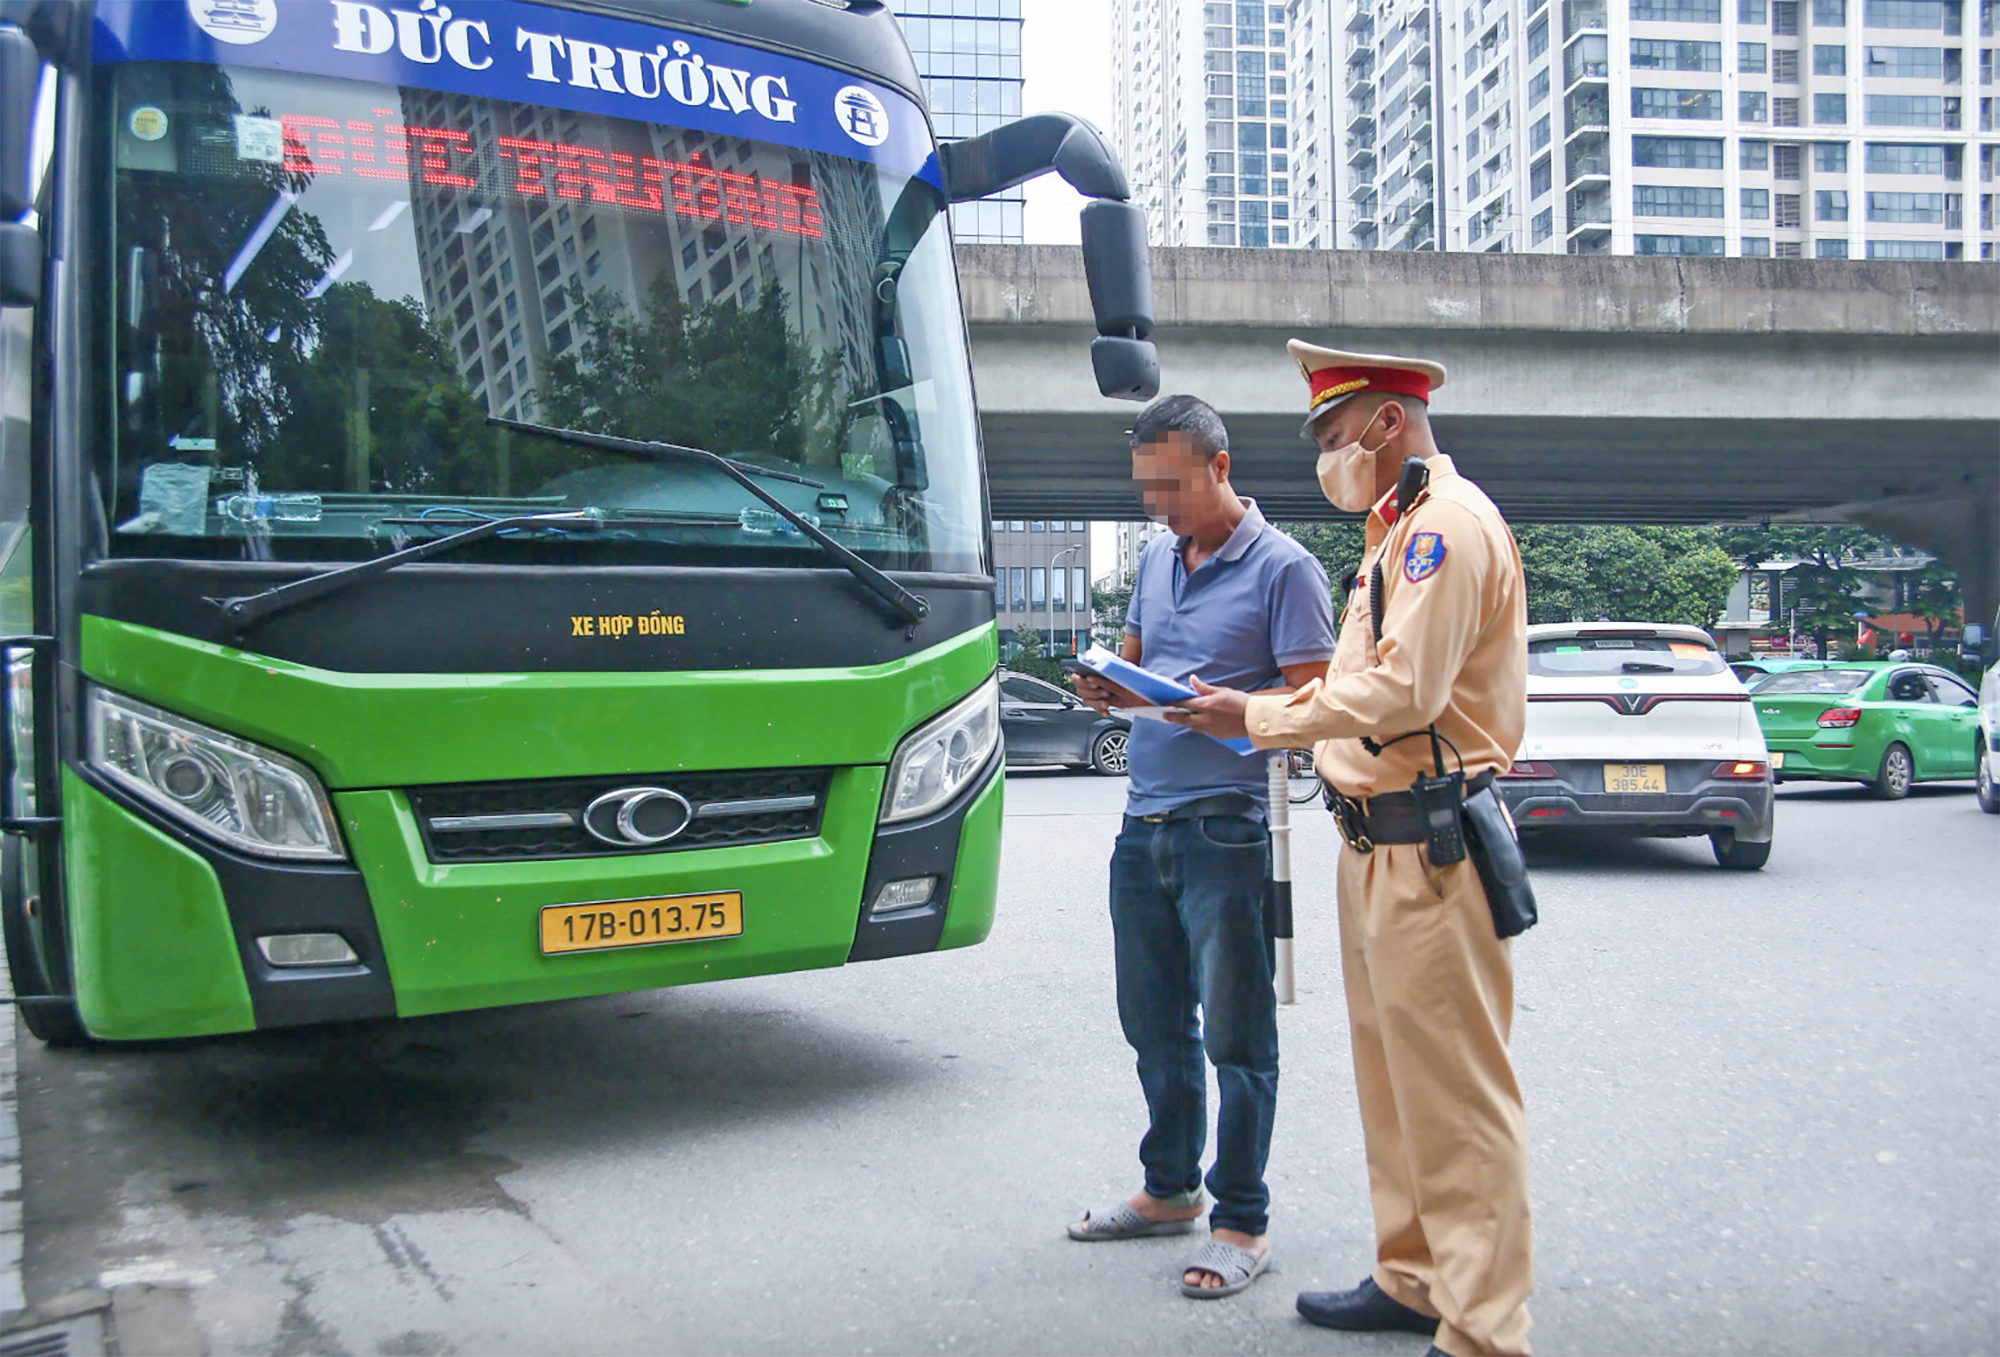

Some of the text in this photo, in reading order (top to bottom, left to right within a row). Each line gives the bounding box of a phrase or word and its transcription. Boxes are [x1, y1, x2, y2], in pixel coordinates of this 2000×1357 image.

[330, 0, 797, 123] ĐỨC TRƯỞNG
[571, 610, 685, 640] XE HỢP ĐỒNG
[1612, 778, 1659, 791] 385.44
[1622, 765, 1648, 778] 30E
[564, 902, 725, 942] 17B-013.75
